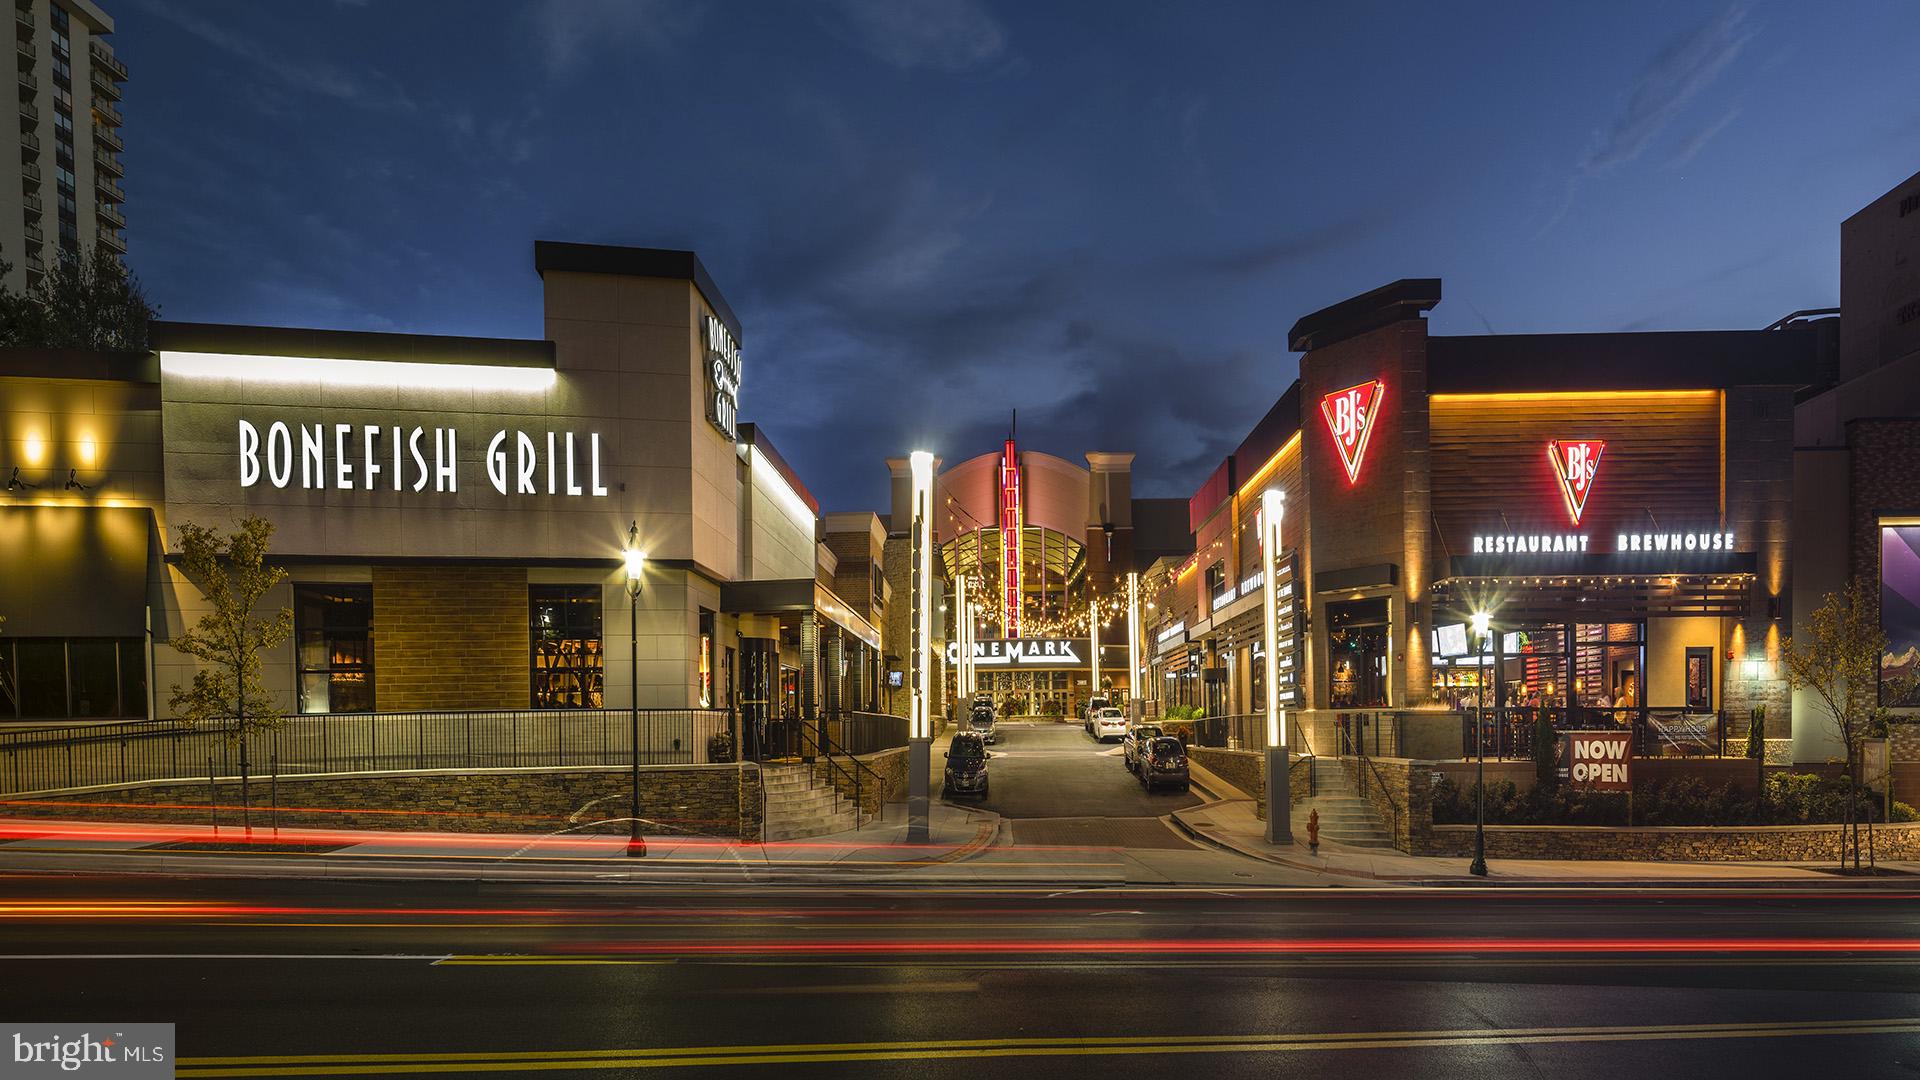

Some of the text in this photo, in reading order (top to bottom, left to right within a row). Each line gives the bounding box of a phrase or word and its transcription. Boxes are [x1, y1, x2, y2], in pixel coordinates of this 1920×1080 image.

[715, 392, 737, 441] GRILL
[1335, 390, 1366, 446] BJ's
[239, 419, 609, 497] BONEFISH GRILL
[1567, 443, 1595, 491] BJ's
[1473, 533, 1735, 553] RESTAURANT BREWHOUSE
[946, 641, 1081, 664] CNEMARK
[1574, 740, 1627, 760] NOW
[1572, 762, 1628, 783] OPEN
